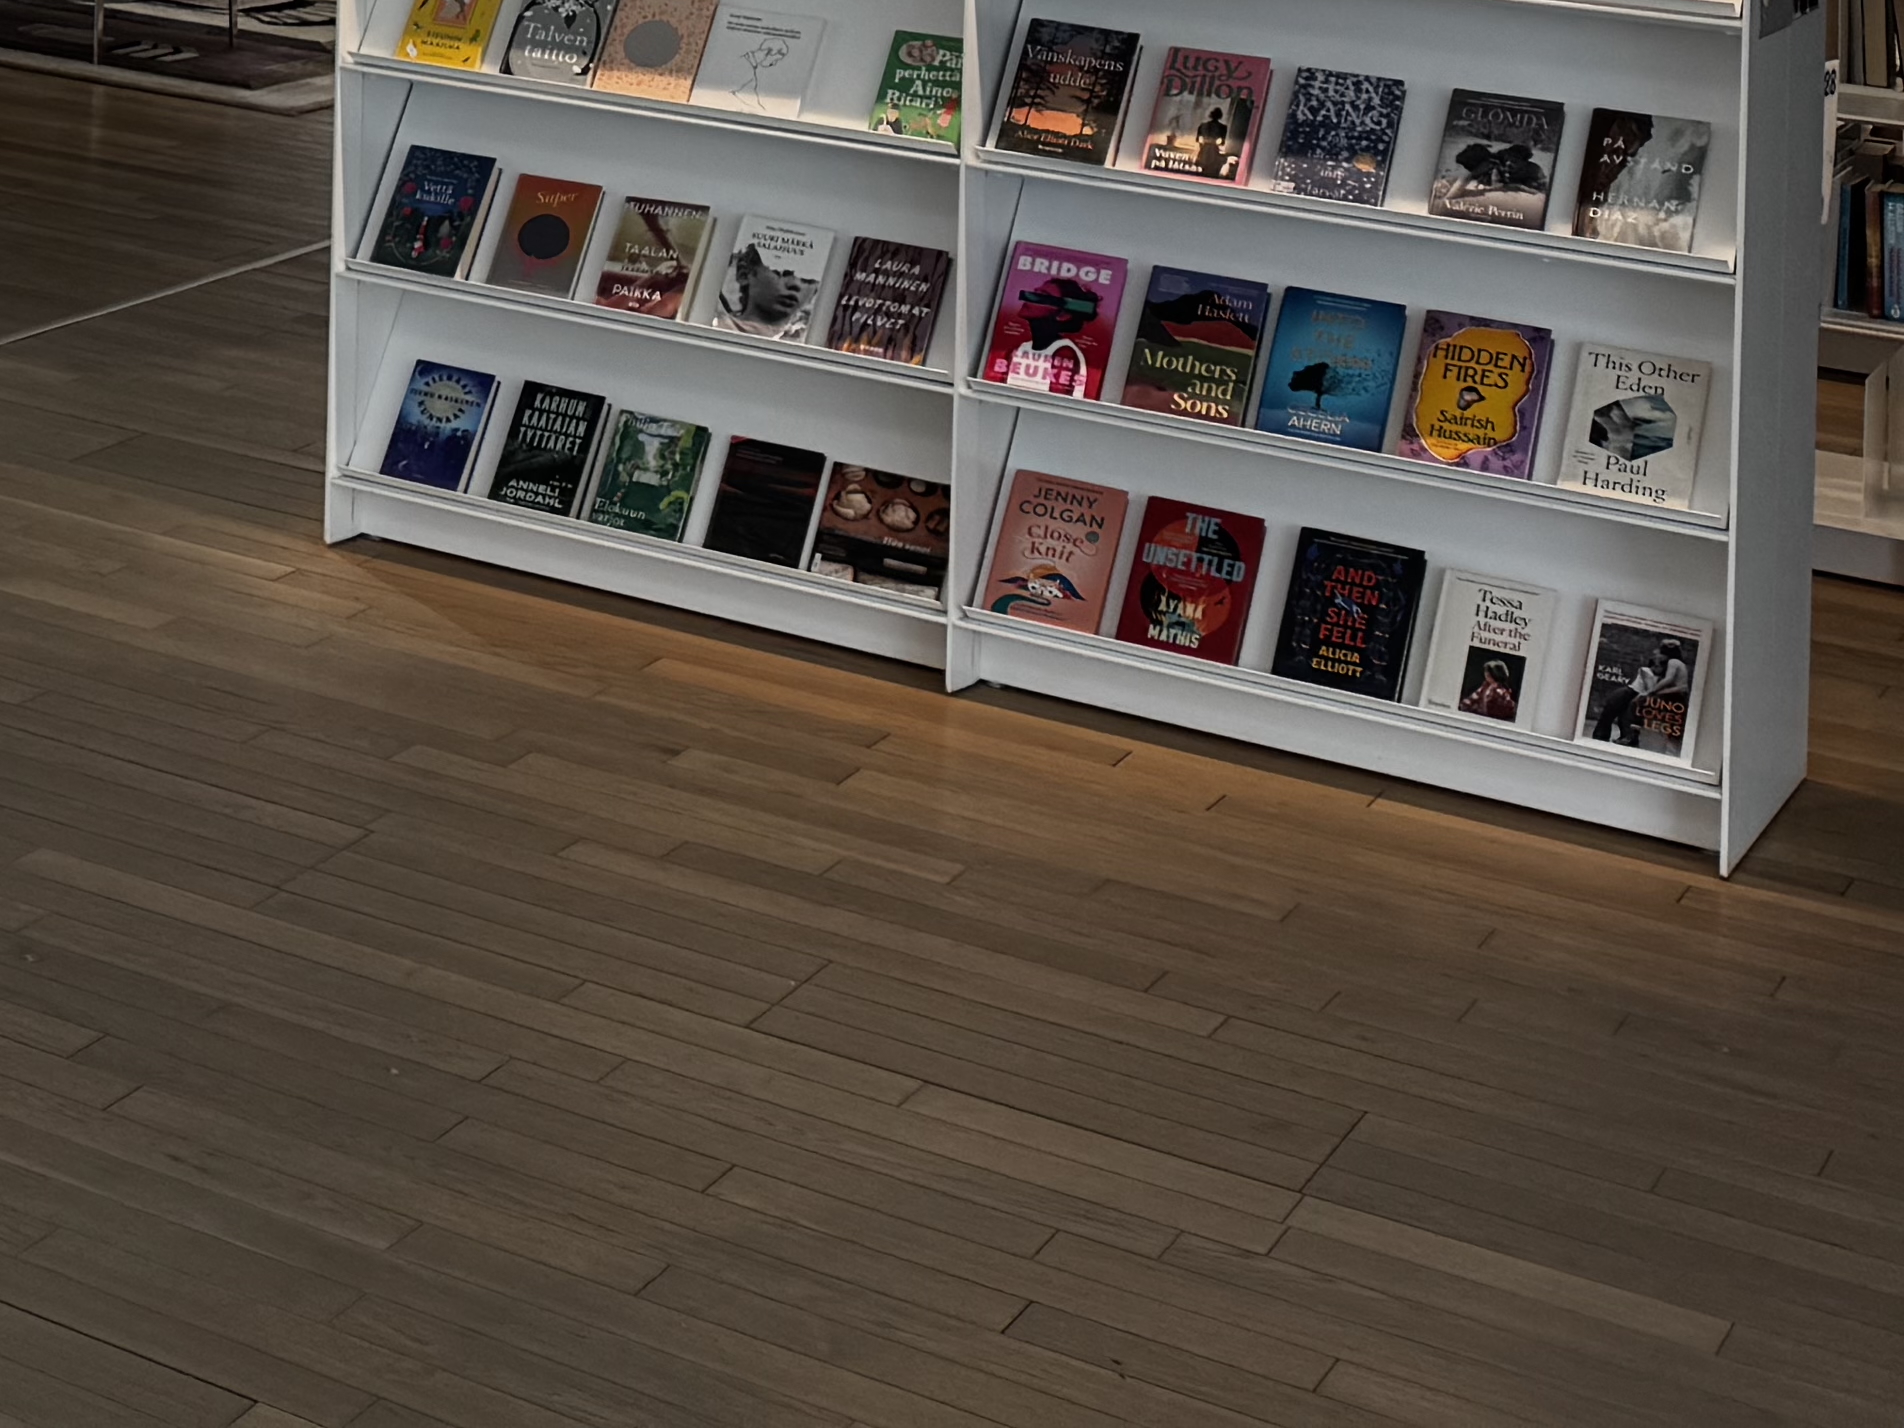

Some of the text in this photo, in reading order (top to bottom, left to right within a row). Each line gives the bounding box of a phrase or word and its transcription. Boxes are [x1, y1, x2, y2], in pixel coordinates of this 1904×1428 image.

[524, 22, 588, 47] Talven
[524, 44, 578, 64] taitto
[1025, 44, 1124, 72] Vänskapens
[1169, 47, 1253, 82] Lucy
[895, 66, 960, 83] perhettä
[1049, 71, 1092, 87] udde
[909, 80, 952, 97] Aino
[1162, 74, 1256, 101] Dillon
[886, 89, 936, 109] Ritari
[1296, 94, 1387, 130] KANG
[1070, 137, 1094, 150] Dark
[415, 191, 455, 206] kukille
[424, 181, 455, 195] Vettä
[536, 191, 579, 208] Super
[628, 201, 703, 219] TUHANNEN
[625, 242, 679, 259] TAALAN
[874, 258, 920, 275] LAURA
[1017, 255, 1113, 285] BRIDGE
[612, 283, 661, 301] PAIKKA
[854, 272, 931, 293] MANNINEN
[841, 295, 931, 318] LEVOTTOMAT
[1209, 293, 1253, 310] Adam
[851, 312, 907, 330] PILVET
[1012, 349, 1074, 369] LAUREN
[1141, 348, 1238, 381] Mothers
[1433, 341, 1530, 374] HIDDEN
[1588, 351, 1701, 385] This Other
[994, 359, 1087, 387] BEUKES
[1443, 362, 1511, 391] FIRES
[1187, 379, 1233, 401] and
[1614, 375, 1666, 396] Eden
[534, 393, 587, 418] KARHUN
[1170, 393, 1229, 419] Sons
[522, 410, 587, 438] KAATAJAN
[1288, 416, 1342, 435] AHERN
[1437, 409, 1496, 432] Sairish
[518, 427, 583, 456] TYTTÄRET
[1429, 424, 1498, 445] Hussain
[1605, 454, 1648, 478] Paul
[500, 486, 563, 508] JORDAHL
[508, 478, 560, 498] ANNELI
[1033, 486, 1099, 509] JENNY
[1582, 470, 1667, 504] Harding
[594, 497, 646, 519] Elokuun
[1019, 500, 1105, 530] COLGAN
[1027, 524, 1086, 548] Close
[1185, 512, 1222, 539] THE
[1030, 541, 1074, 563] Knit
[1142, 542, 1246, 582] UNSETTLED
[1331, 564, 1377, 587] AND
[1323, 579, 1380, 606] THEN
[1478, 588, 1523, 610] Tessa
[1158, 594, 1205, 620] AYANA
[1326, 606, 1368, 630] SHE
[1475, 604, 1532, 628] Hadley
[1147, 624, 1201, 649] MATHIS
[1318, 623, 1367, 648] FELL
[1470, 632, 1521, 652] Funeral
[1471, 620, 1532, 642] After the
[1318, 644, 1361, 663] ALICIA
[1312, 658, 1364, 677] ELLIOTT
[1596, 671, 1630, 685] GEARY
[1598, 665, 1624, 676] KARL
[1636, 706, 1683, 725] LOVES
[1643, 696, 1685, 713] JUNO
[1643, 719, 1682, 737] LEGS
